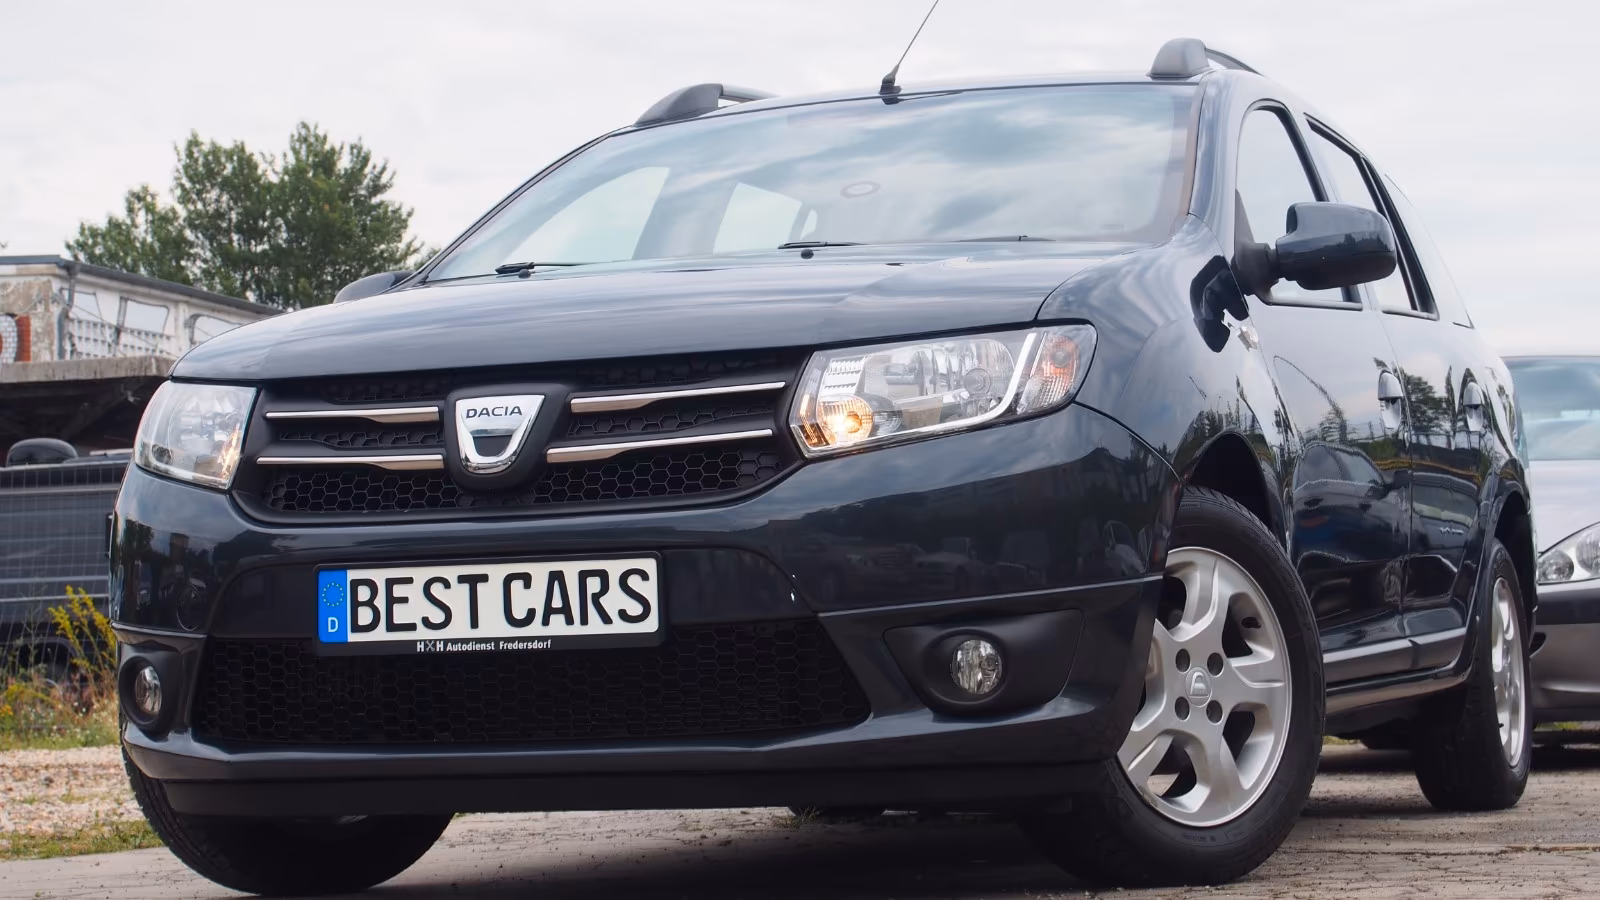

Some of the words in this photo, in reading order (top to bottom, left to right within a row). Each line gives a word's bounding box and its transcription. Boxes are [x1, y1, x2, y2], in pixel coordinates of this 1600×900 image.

[466, 406, 523, 418] DACIA
[350, 573, 489, 633] BEST
[503, 568, 651, 628] CARS
[328, 616, 338, 632] D
[446, 641, 495, 651] Autodienst
[499, 638, 552, 650] Fredersdorf
